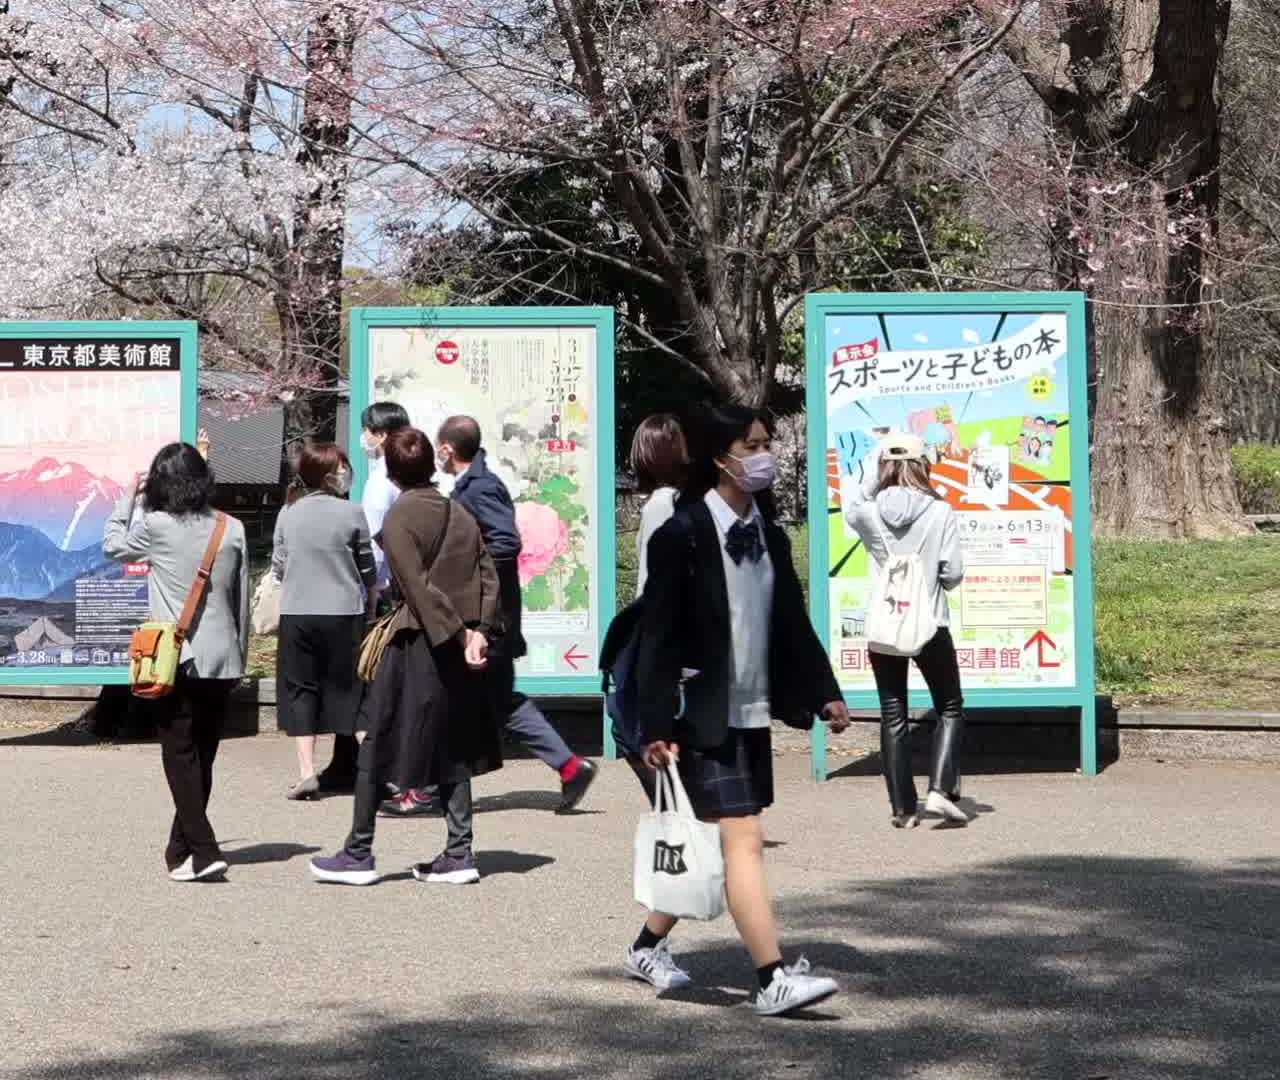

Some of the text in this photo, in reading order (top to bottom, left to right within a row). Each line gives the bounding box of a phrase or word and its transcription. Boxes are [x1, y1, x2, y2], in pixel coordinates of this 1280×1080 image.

[22, 343, 172, 368] 東京都美術館
[828, 327, 1062, 397] スポーツと子どもの本
